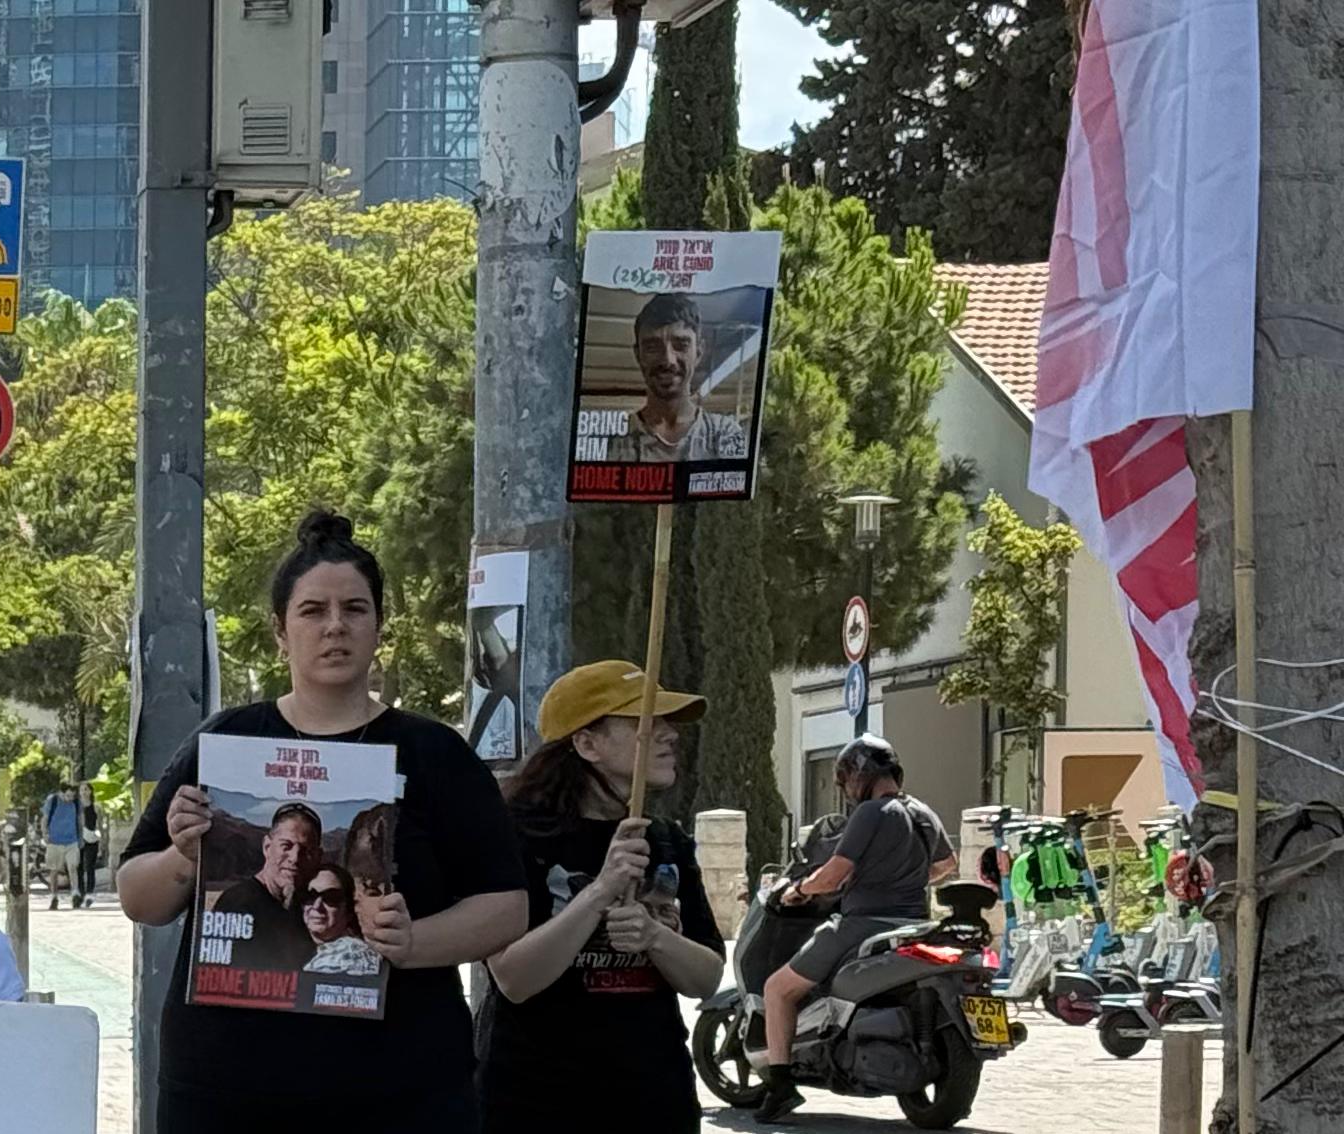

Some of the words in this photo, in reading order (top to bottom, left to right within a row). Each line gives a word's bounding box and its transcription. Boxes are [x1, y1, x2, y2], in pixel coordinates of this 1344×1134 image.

[652, 256, 681, 271] ARIEL
[683, 256, 714, 271] CUNIO
[577, 411, 629, 436] BRING
[575, 437, 609, 461] HIM
[573, 466, 623, 490] HOME
[625, 464, 674, 490] NOW!
[264, 762, 297, 778] RONEN
[299, 765, 330, 781] ANGEL
[287, 781, 308, 796] (54)
[202, 911, 255, 939] BRING
[198, 938, 233, 965] HIM
[196, 967, 243, 993] HOME
[247, 970, 299, 998] NOW!
[977, 1017, 993, 1034] 68
